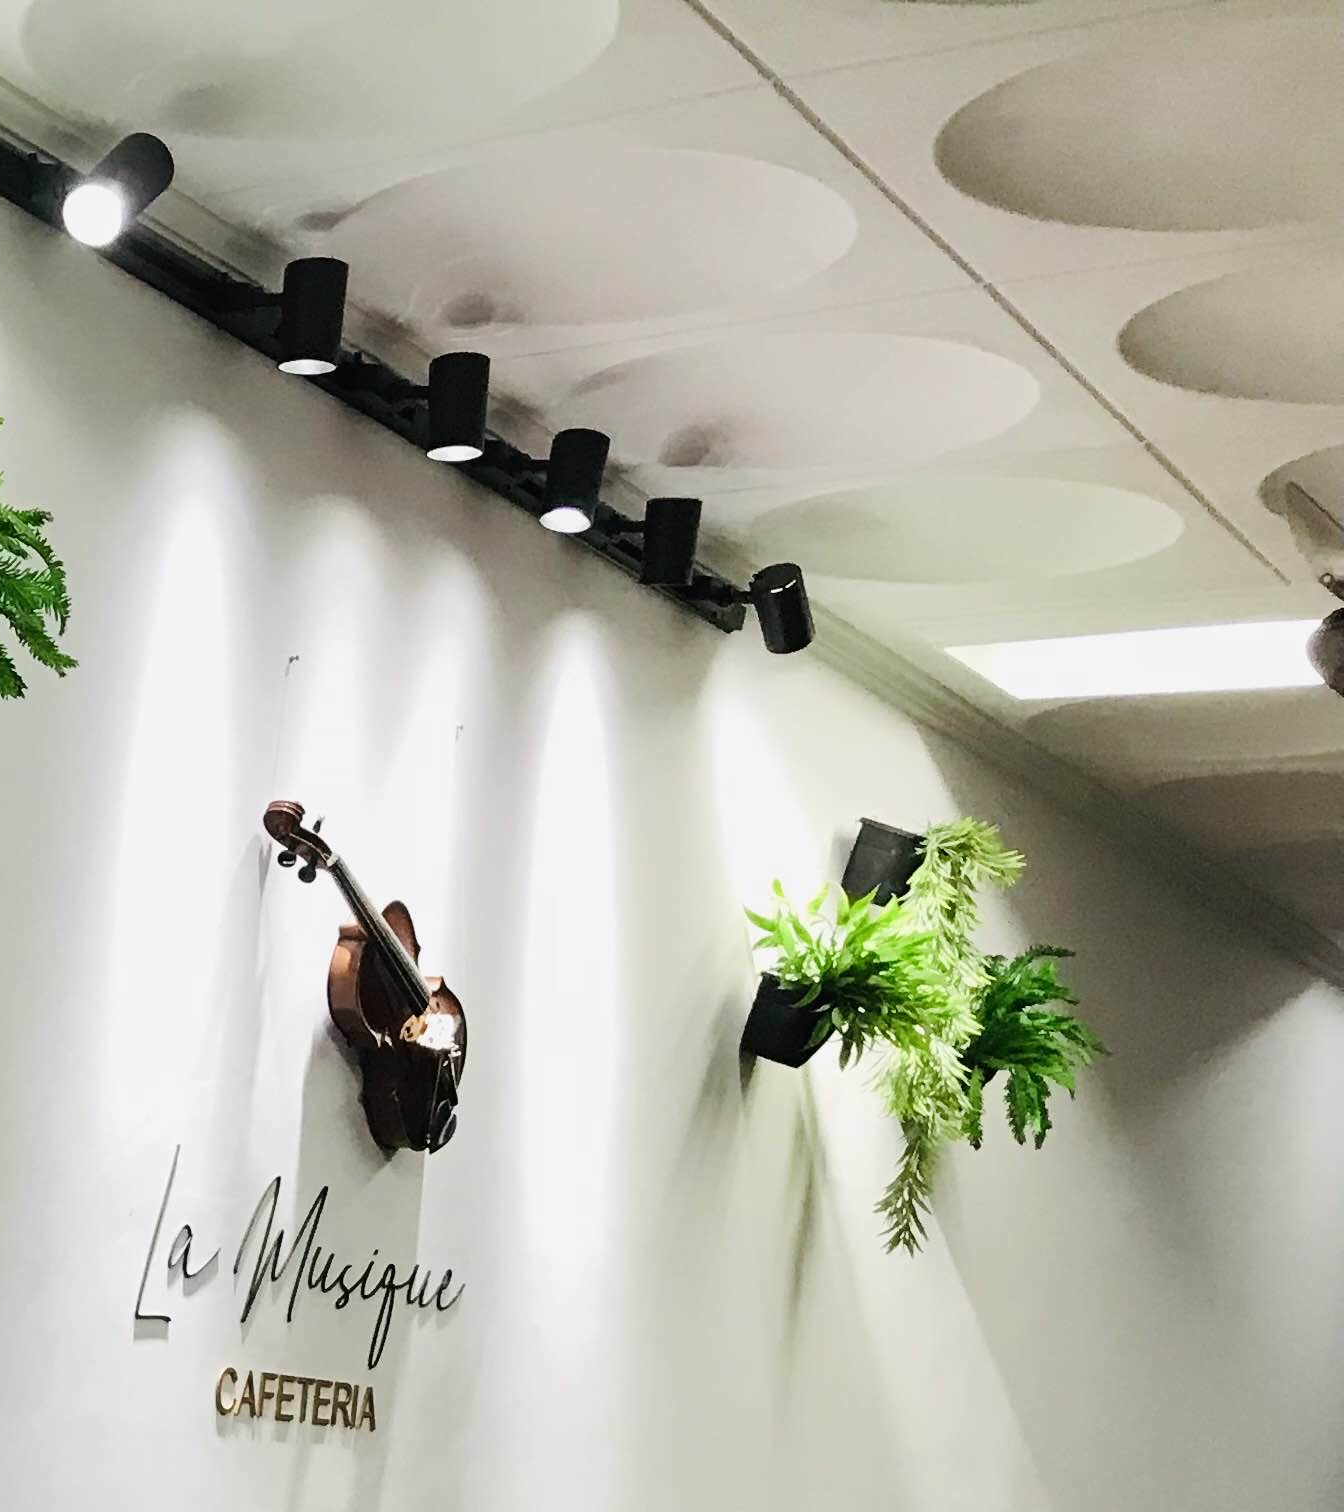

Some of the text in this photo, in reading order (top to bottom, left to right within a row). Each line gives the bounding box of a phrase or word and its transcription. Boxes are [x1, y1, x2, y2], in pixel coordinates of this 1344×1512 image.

[135, 1143, 466, 1370] La Musique
[215, 1366, 377, 1433] CAFETERIA
